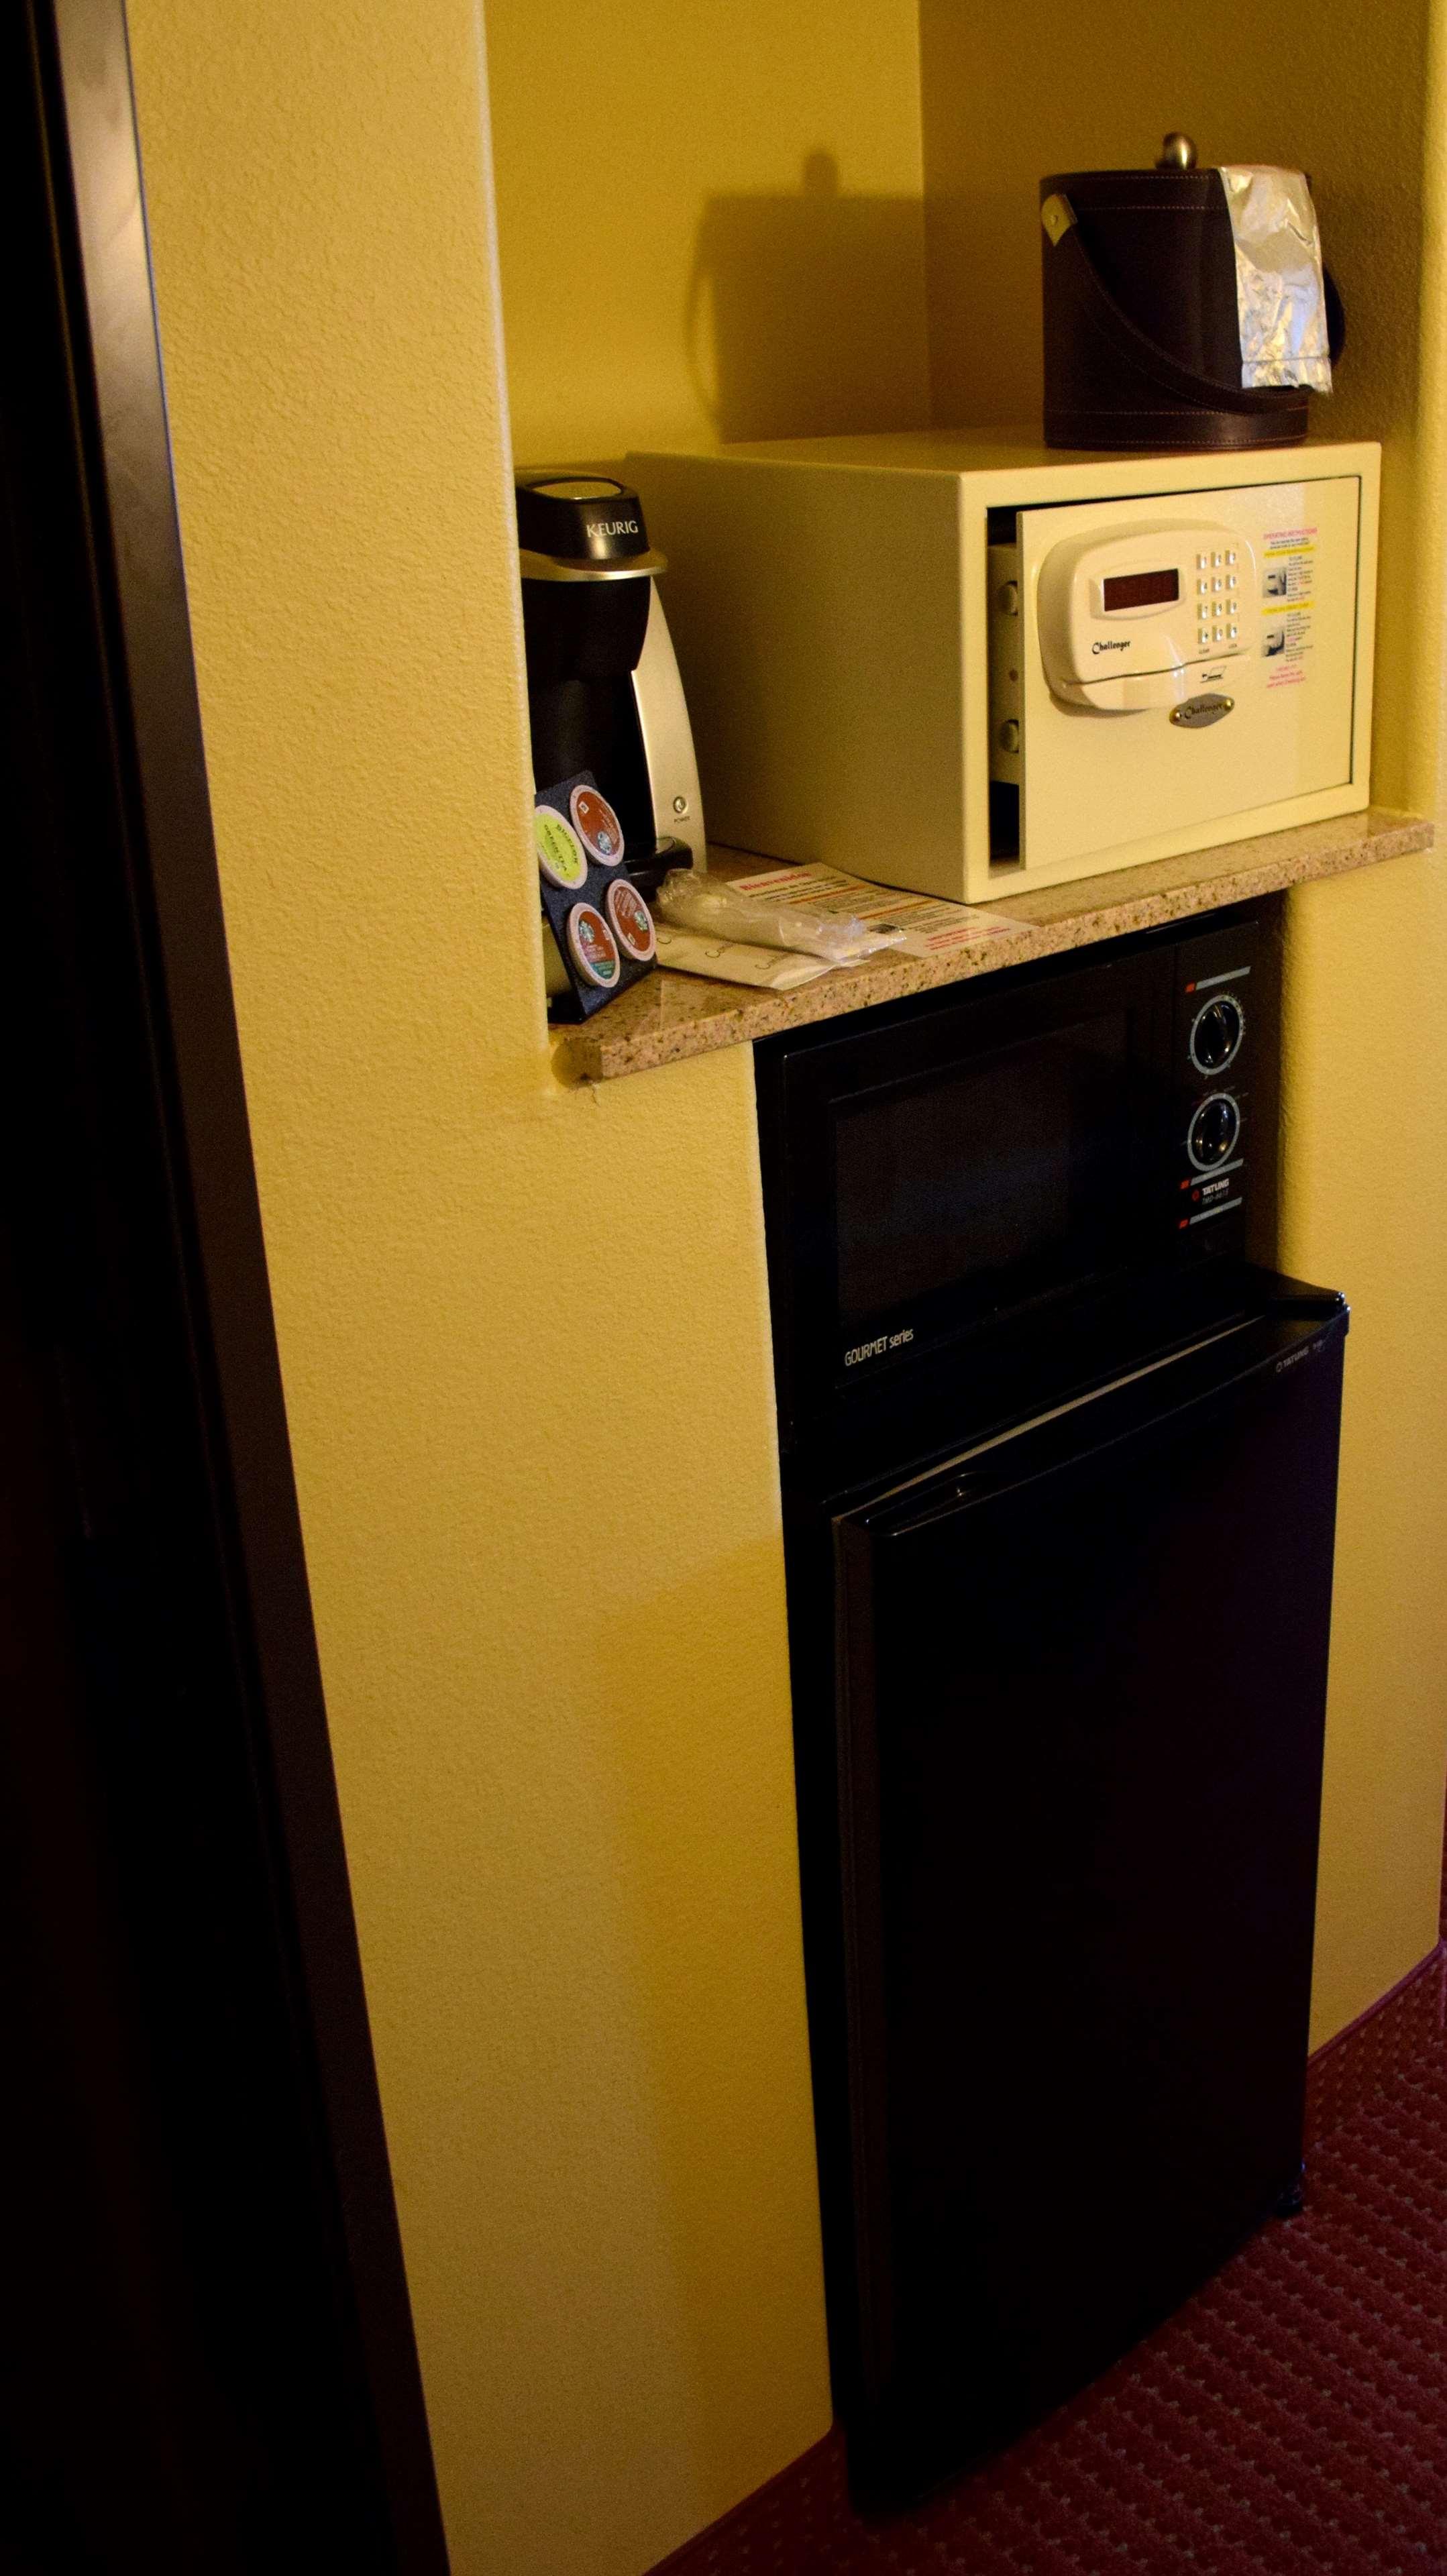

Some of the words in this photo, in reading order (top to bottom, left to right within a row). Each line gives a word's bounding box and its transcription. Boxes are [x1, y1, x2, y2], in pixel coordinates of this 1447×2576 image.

[586, 520, 639, 538] KEURIG
[1092, 641, 1131, 655] Challenger
[1185, 704, 1223, 719] Challenger
[845, 1336, 888, 1366] GOURMET
[889, 1328, 914, 1349] series
